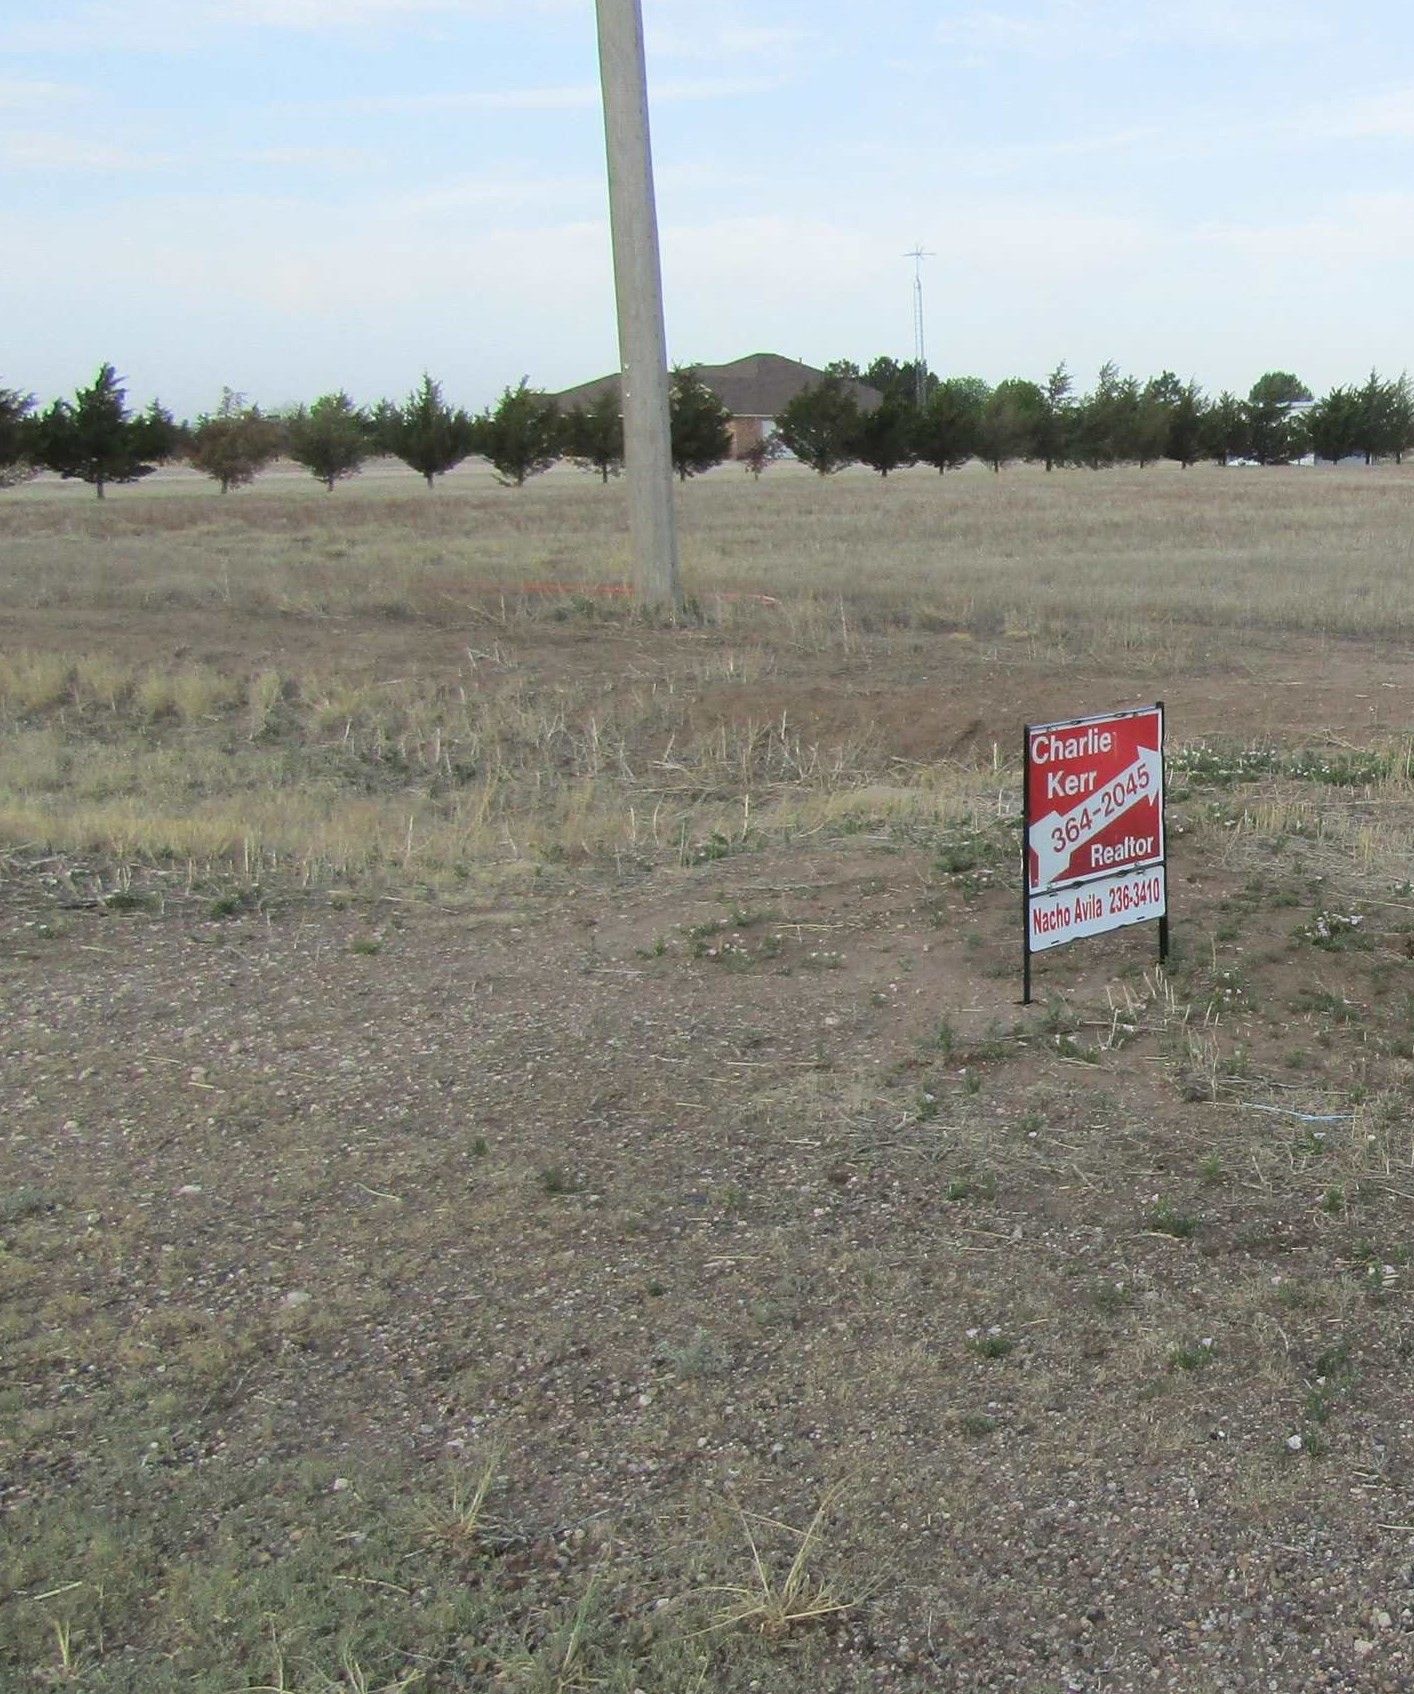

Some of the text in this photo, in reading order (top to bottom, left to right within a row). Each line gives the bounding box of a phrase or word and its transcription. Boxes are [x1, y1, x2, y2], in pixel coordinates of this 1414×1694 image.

[1031, 732, 1112, 765] Charlie
[1047, 769, 1097, 799] Kerr
[1050, 763, 1150, 853] 364-2045
[1091, 836, 1154, 868] Realtor
[1033, 877, 1160, 935] Nacho Avila 236-3410
